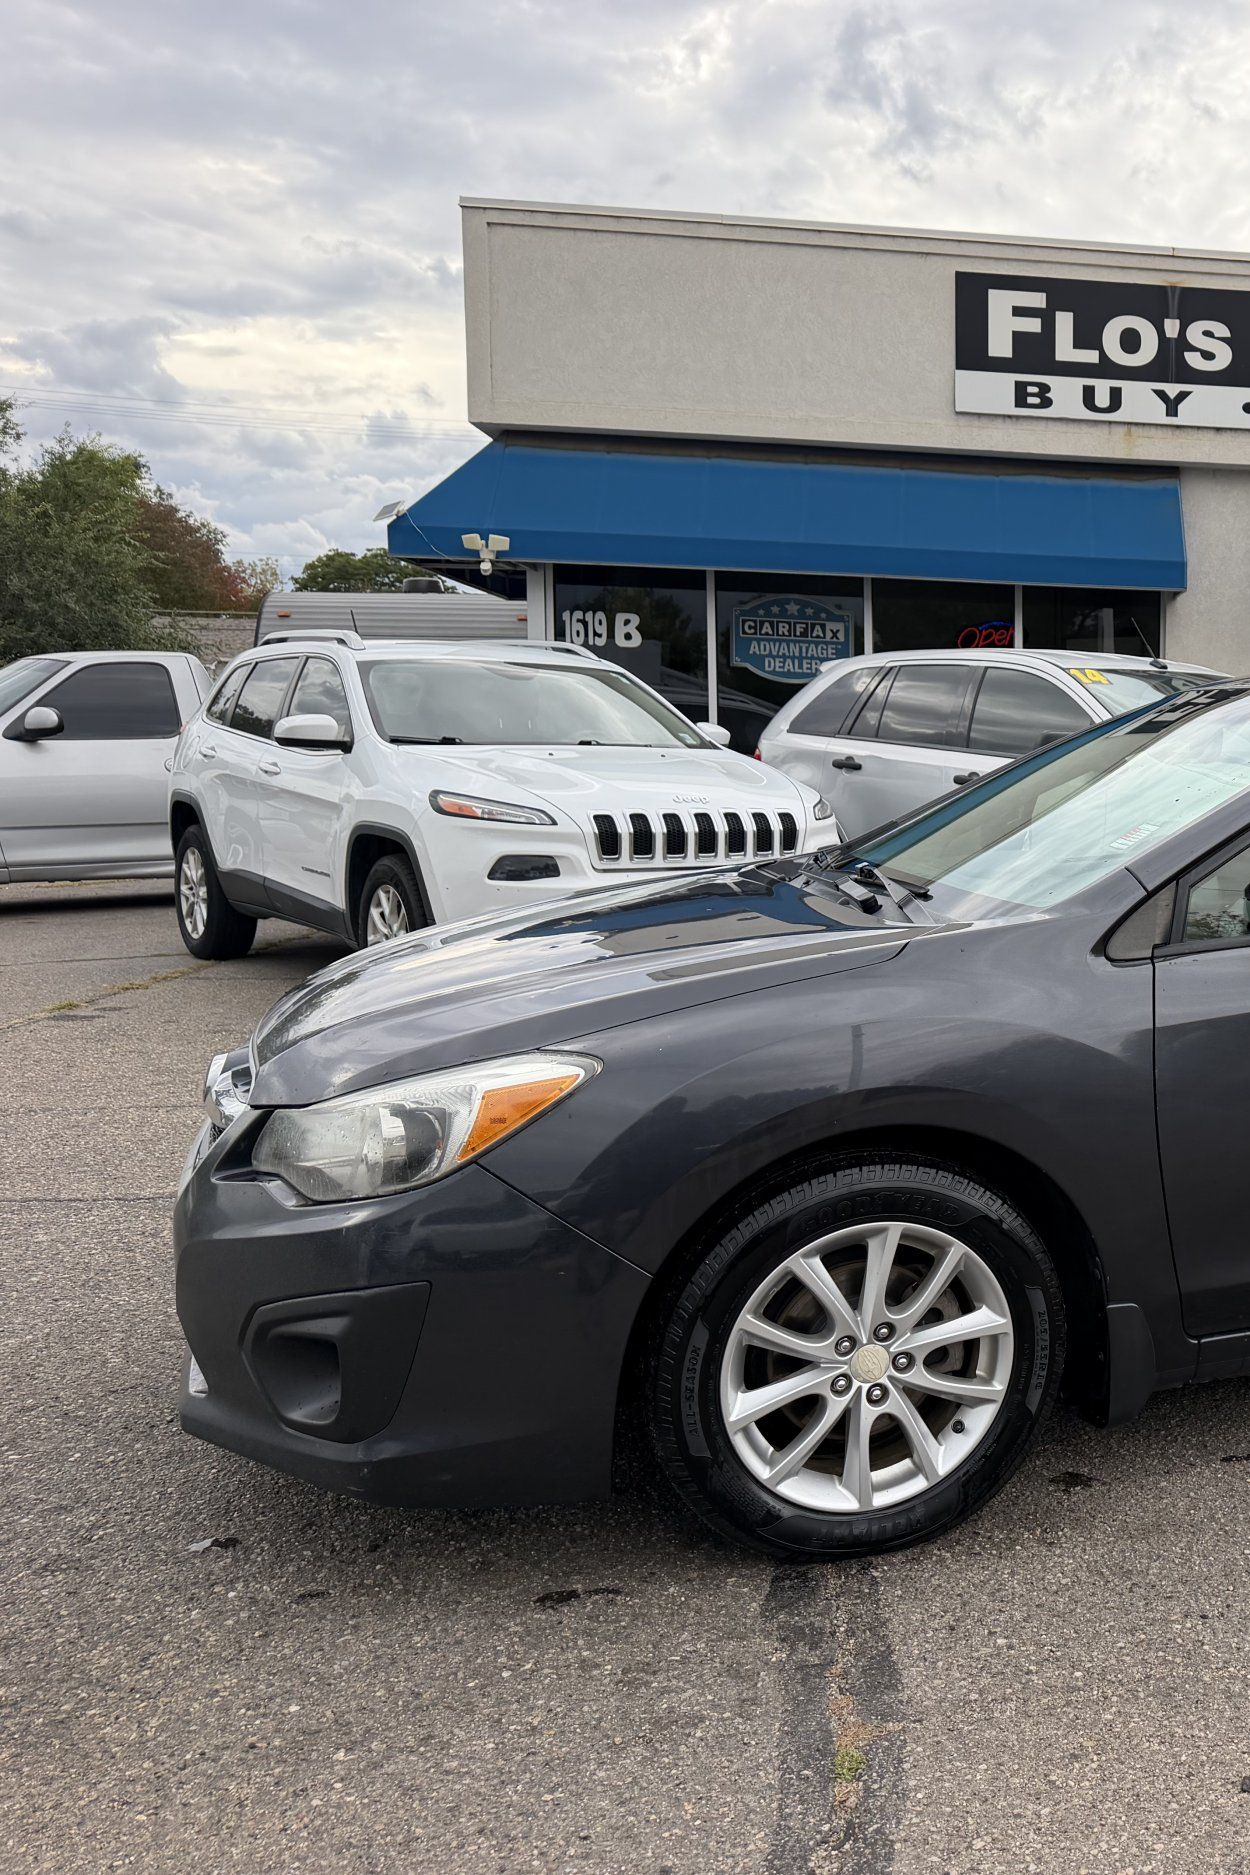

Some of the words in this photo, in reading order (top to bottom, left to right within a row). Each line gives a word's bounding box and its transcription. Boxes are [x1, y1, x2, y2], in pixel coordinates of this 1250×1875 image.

[1014, 380, 1194, 418] BUY
[562, 610, 607, 646] 1619
[615, 612, 642, 648] B
[743, 620, 841, 640] CARFAX
[1069, 668, 1113, 685] 14
[684, 1344, 702, 1438] ALL-SEASON
